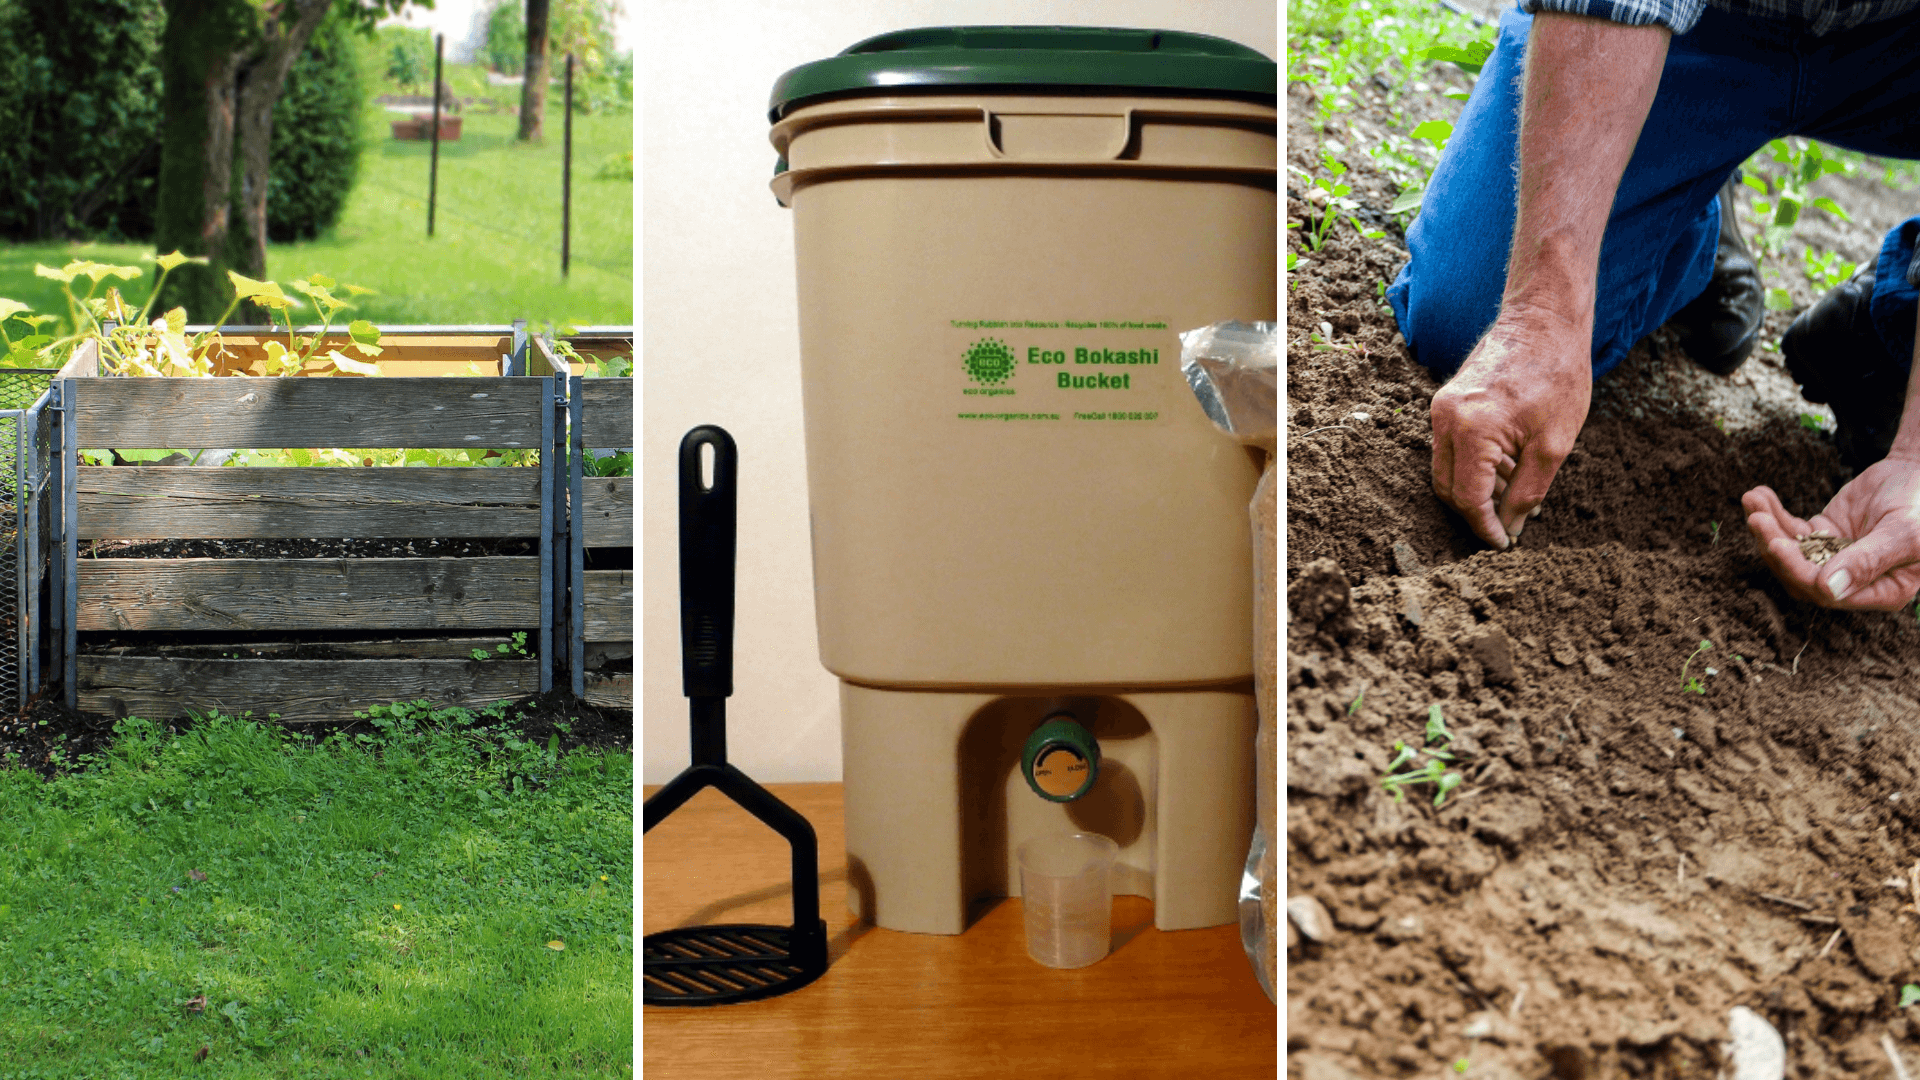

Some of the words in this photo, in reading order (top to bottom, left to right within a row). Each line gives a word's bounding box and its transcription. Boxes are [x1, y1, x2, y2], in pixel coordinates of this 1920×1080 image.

[979, 357, 1000, 367] eco
[1027, 346, 1065, 364] Eco
[1075, 347, 1159, 365] Bokashi
[1057, 372, 1131, 390] Bucket
